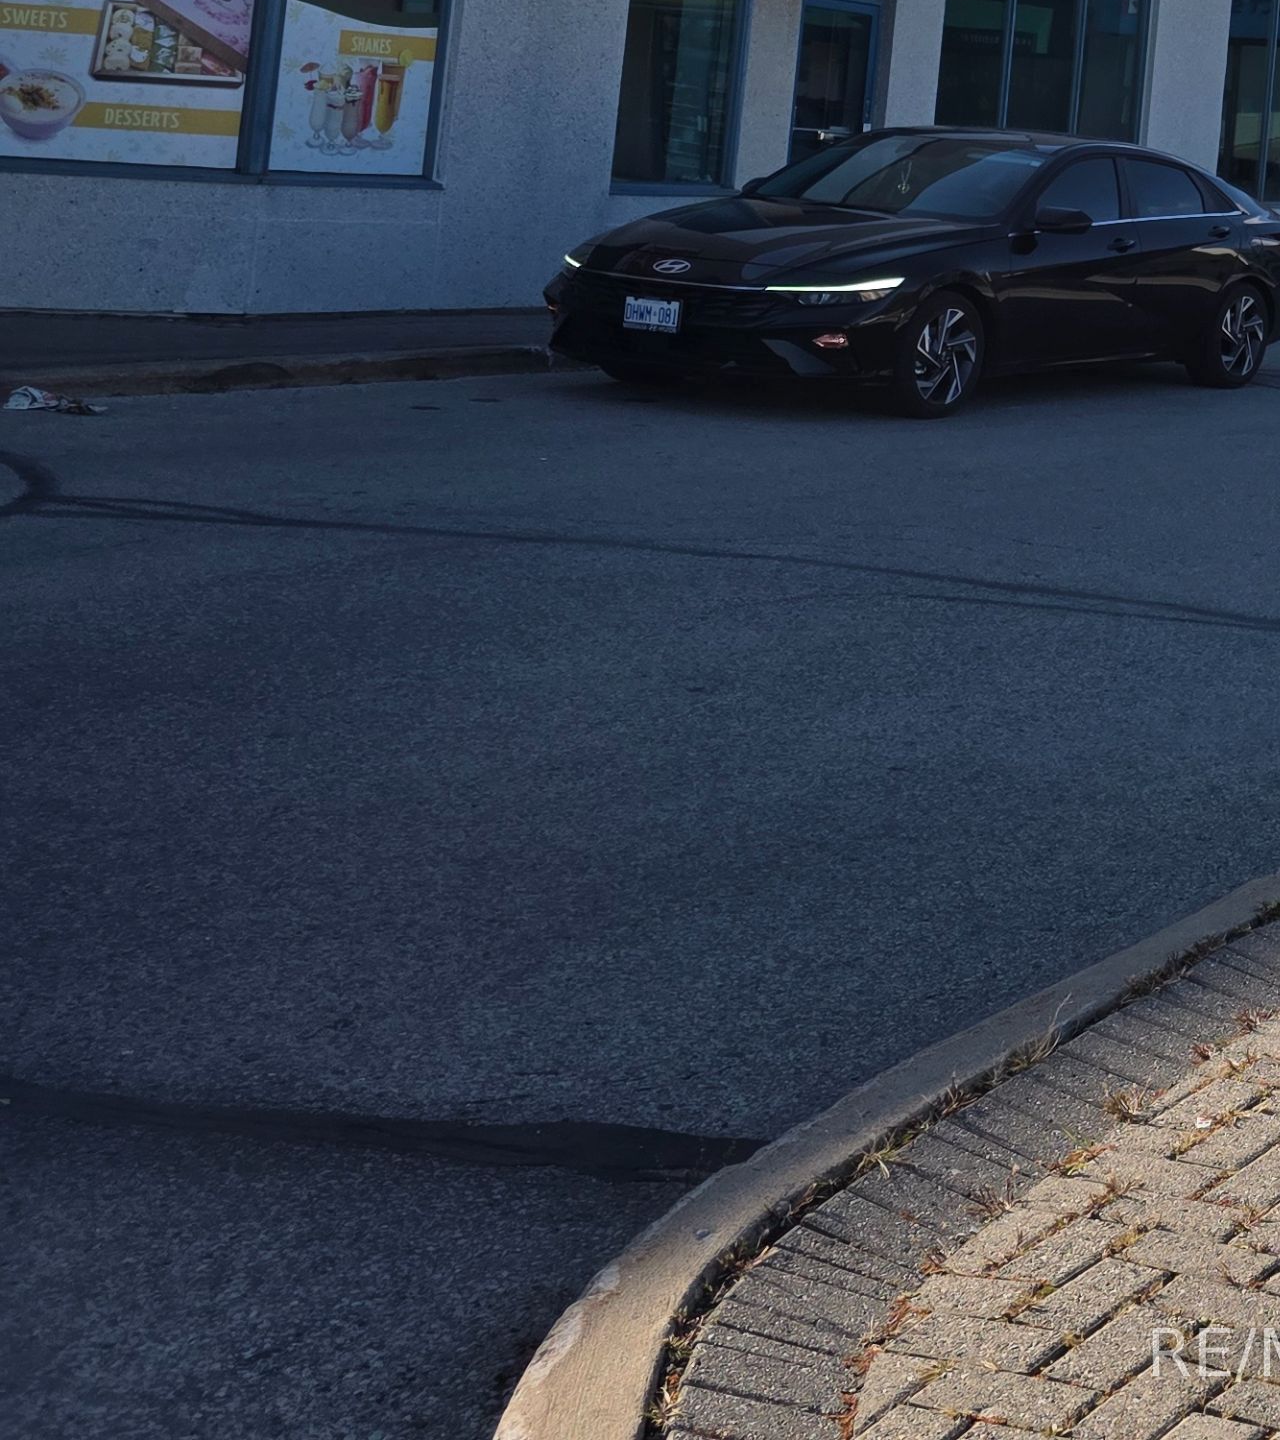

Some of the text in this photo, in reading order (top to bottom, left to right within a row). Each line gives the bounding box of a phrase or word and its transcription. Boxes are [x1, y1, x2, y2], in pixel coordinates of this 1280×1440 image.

[2, 7, 68, 29] SWEETS
[351, 36, 392, 54] SHAKES
[104, 108, 180, 129] DESSERTS
